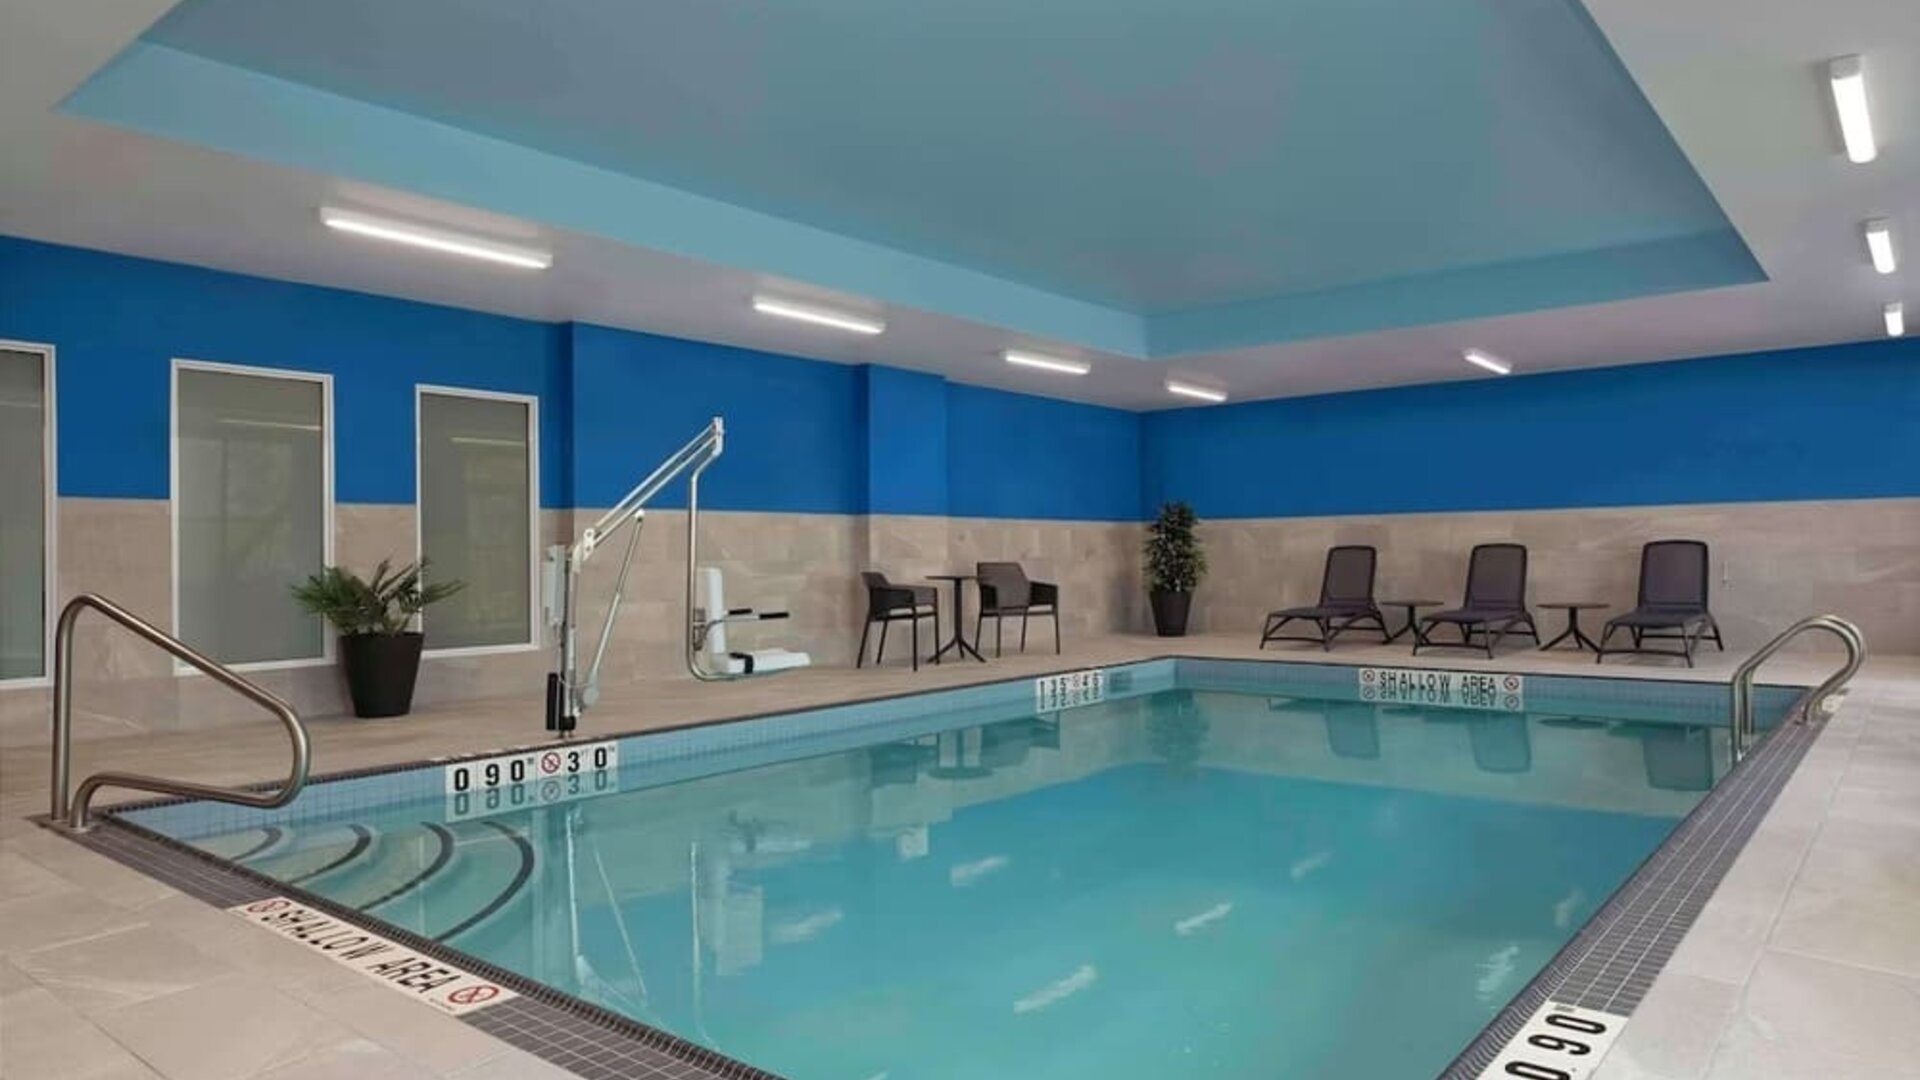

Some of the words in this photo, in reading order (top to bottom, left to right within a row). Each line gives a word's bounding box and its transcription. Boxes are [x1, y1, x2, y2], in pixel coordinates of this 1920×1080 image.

[1380, 671, 1451, 689] SHALLOW
[1461, 676, 1496, 691] AREA
[454, 759, 525, 791] 090
[260, 909, 395, 960] SHALLOW
[366, 957, 461, 994] AREA
[1505, 1014, 1607, 1080] 090
